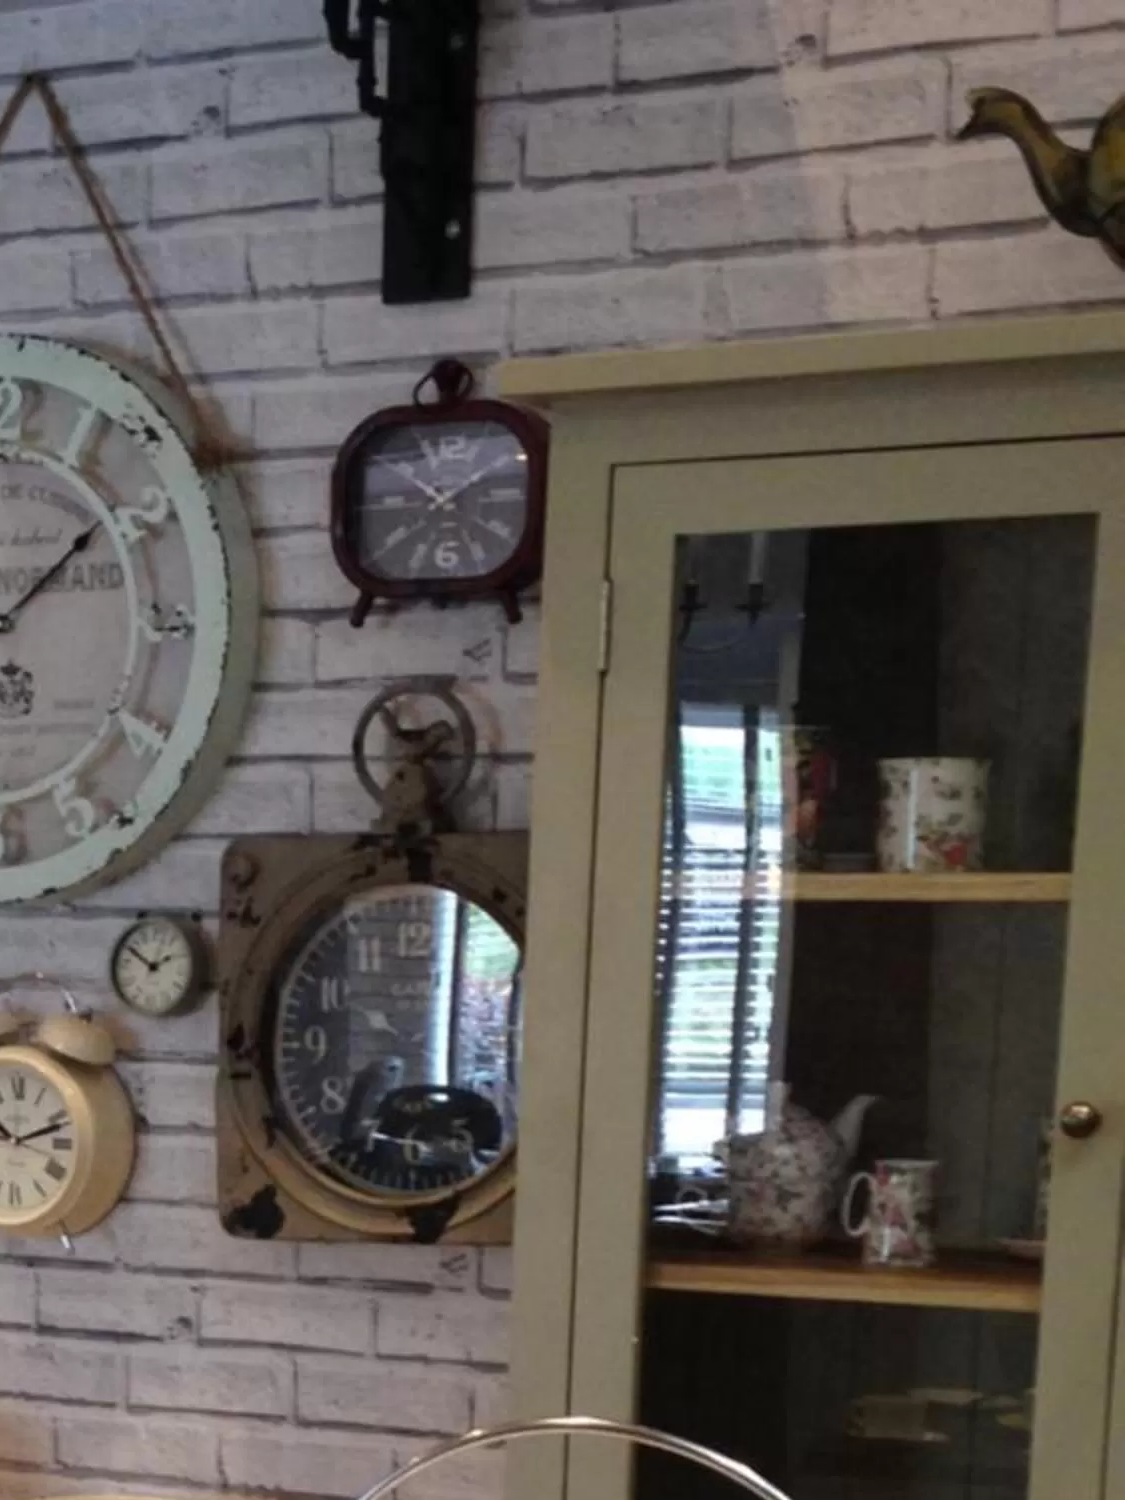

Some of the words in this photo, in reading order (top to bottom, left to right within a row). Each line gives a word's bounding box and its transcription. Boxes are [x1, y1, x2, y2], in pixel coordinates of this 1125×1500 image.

[62, 405, 100, 466] 1
[118, 486, 170, 544] 2
[433, 540, 459, 568] 6
[116, 711, 172, 758] 4
[53, 778, 93, 836] 5
[358, 936, 381, 973] 11
[398, 922, 431, 957] 12
[320, 977, 349, 1013] 10
[304, 1027, 326, 1062] 9
[321, 1077, 345, 1114] 8
[362, 1120, 381, 1153] 7
[447, 1117, 474, 1154] 5
